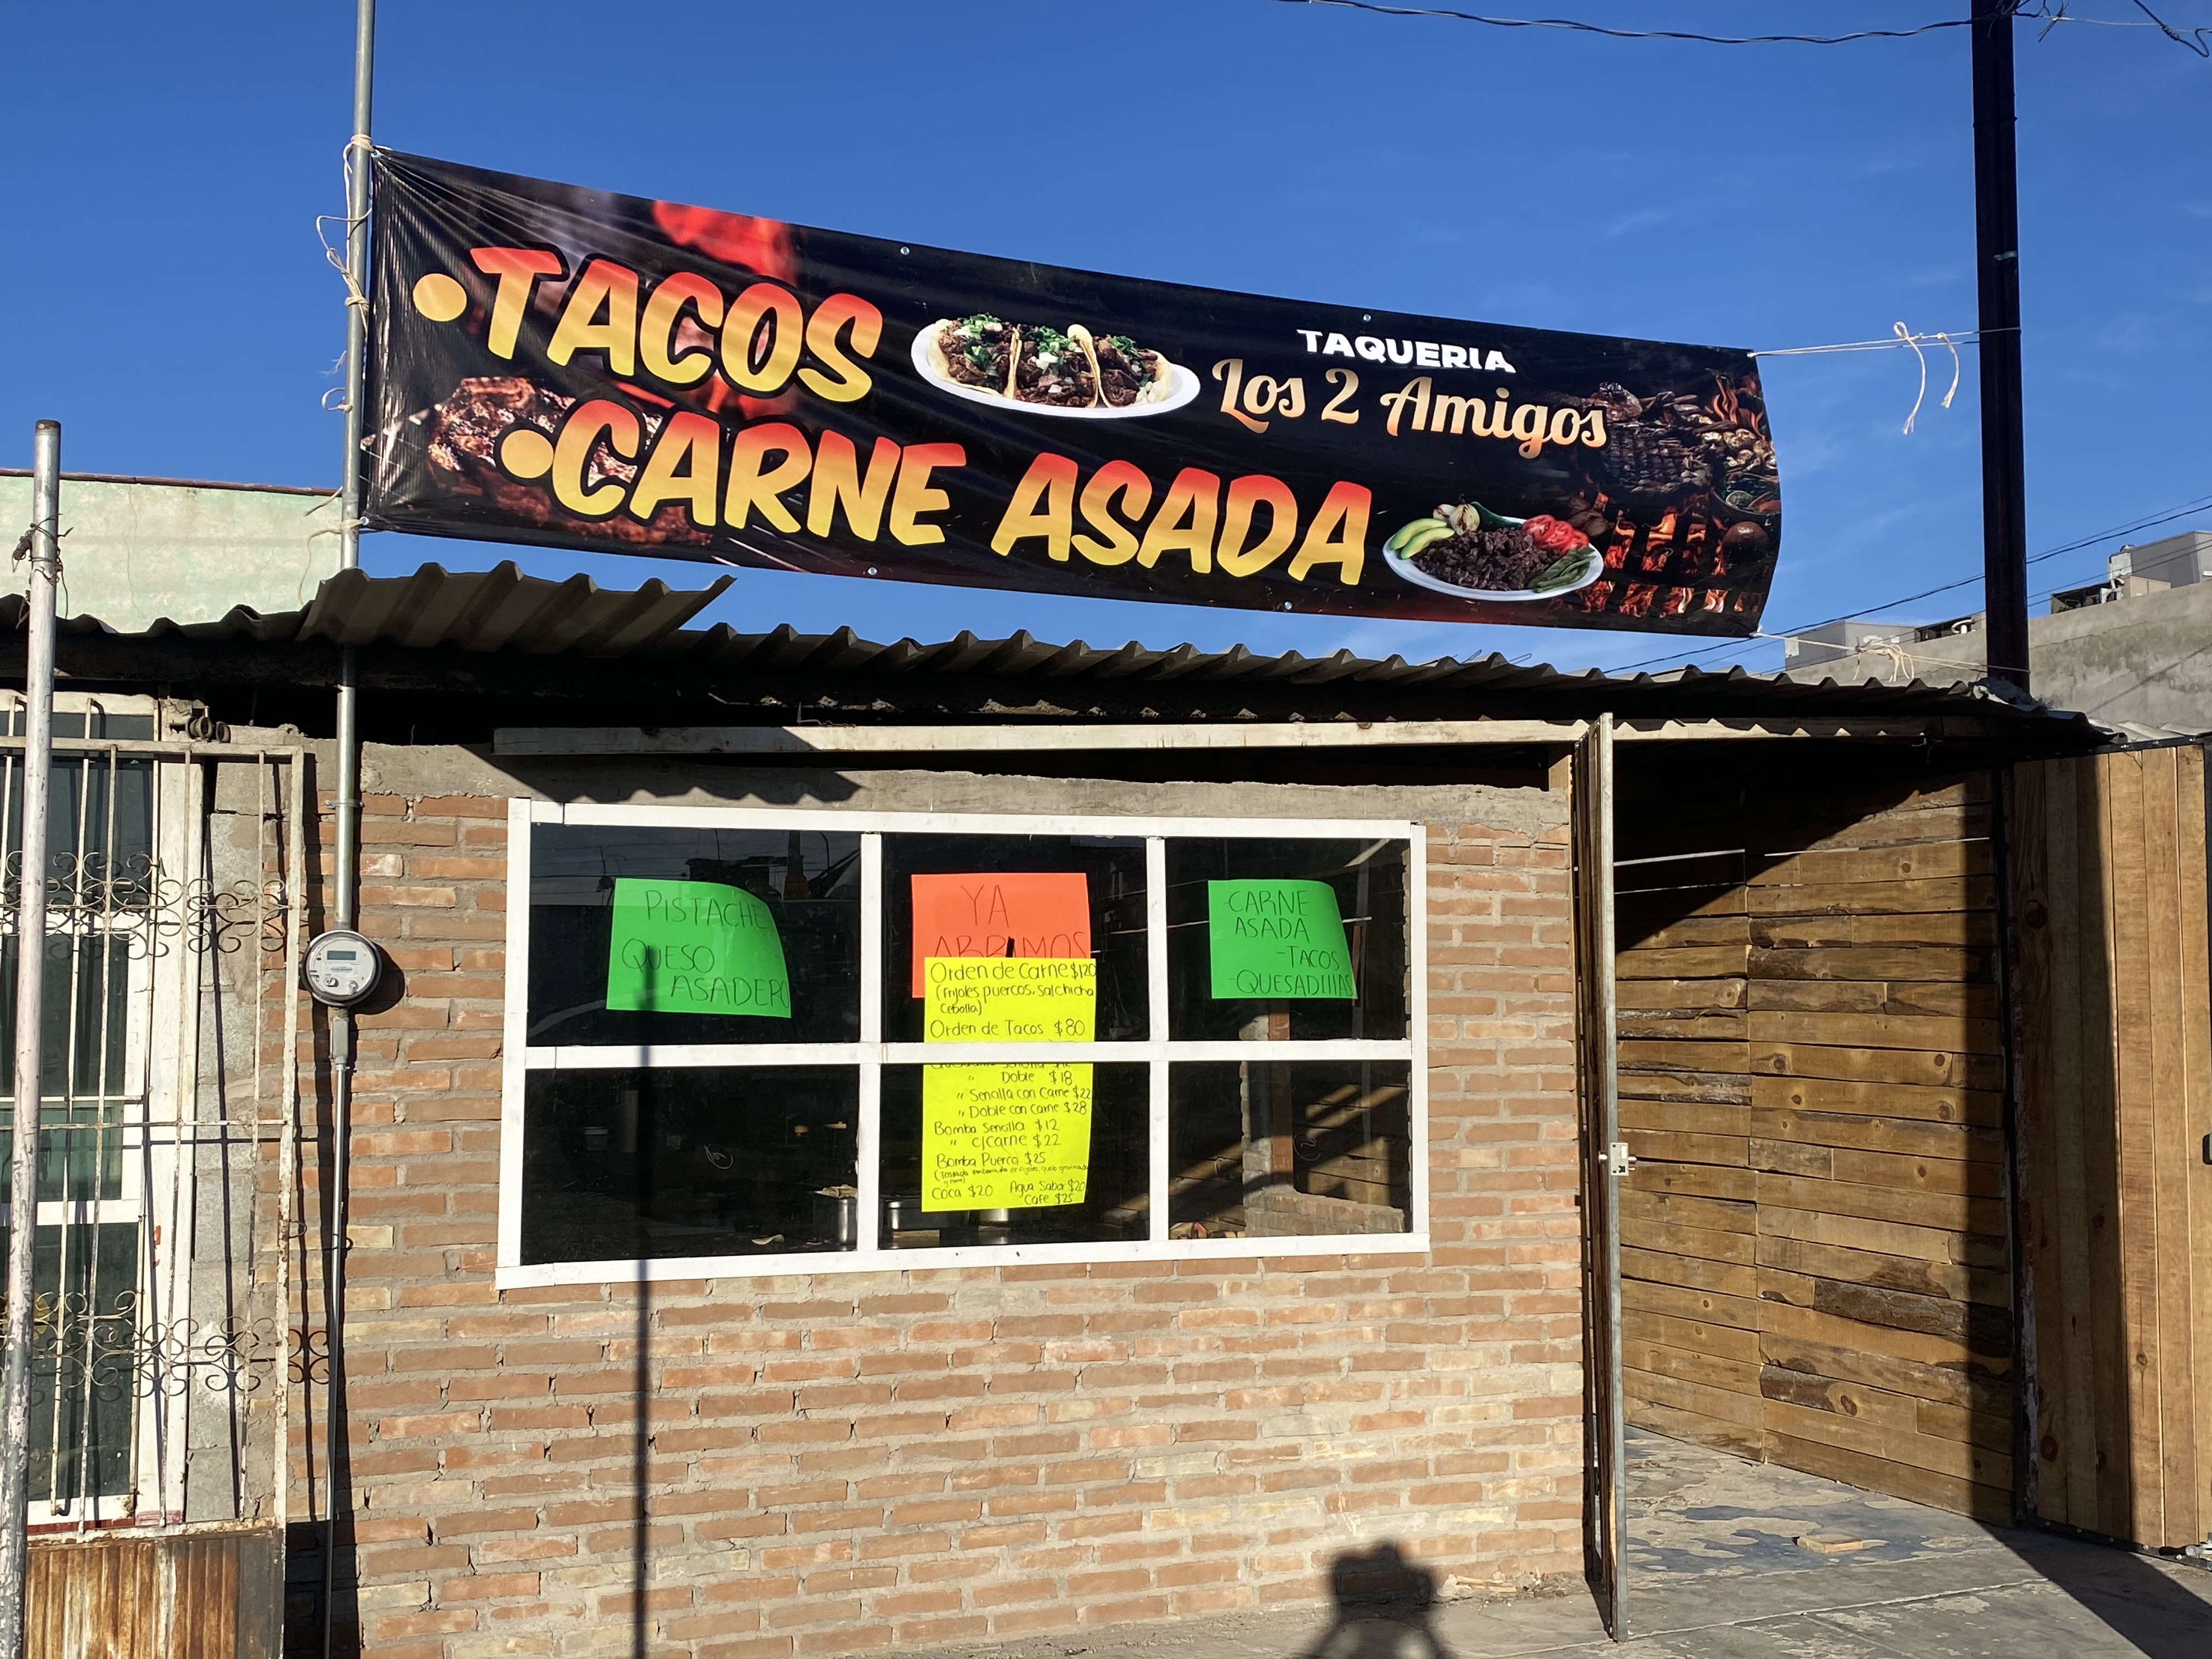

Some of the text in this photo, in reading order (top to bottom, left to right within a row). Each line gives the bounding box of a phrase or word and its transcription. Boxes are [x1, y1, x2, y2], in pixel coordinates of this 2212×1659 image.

[469, 246, 883, 403] TACOS
[1296, 329, 1516, 374] TAQUERIA
[1211, 358, 1608, 460] Los 2 Amigos
[552, 399, 1372, 585] CARNE ASADA
[645, 889, 768, 929] PISTACHE
[960, 884, 1009, 928] YA
[1235, 917, 1310, 943] ASADA
[621, 938, 715, 973] QUESO
[934, 931, 1087, 958] ABRMOS
[930, 961, 1096, 983] Orden de Carne $120
[670, 975, 790, 1009] ASADERO
[930, 1018, 1085, 1038] Orden de Tacos $80
[1001, 1071, 1035, 1084] Doble
[1017, 1089, 1036, 1099] con
[1039, 1087, 1070, 1099] Carne
[1073, 1085, 1091, 1100] $22
[969, 1105, 1006, 1118] Doble
[1009, 1105, 1027, 1115] con
[1030, 1103, 1059, 1115] Carne
[1063, 1101, 1087, 1115] $28
[934, 1118, 1060, 1135] Bomba Sencilla $12
[1032, 1133, 1061, 1149] $22
[936, 1151, 1046, 1169] Bomba Puerca $25
[932, 1184, 994, 1200] Coca $20
[1009, 1180, 1035, 1198] Agua
[1067, 1178, 1086, 1192] $20
[1054, 1193, 1075, 1205] $25
